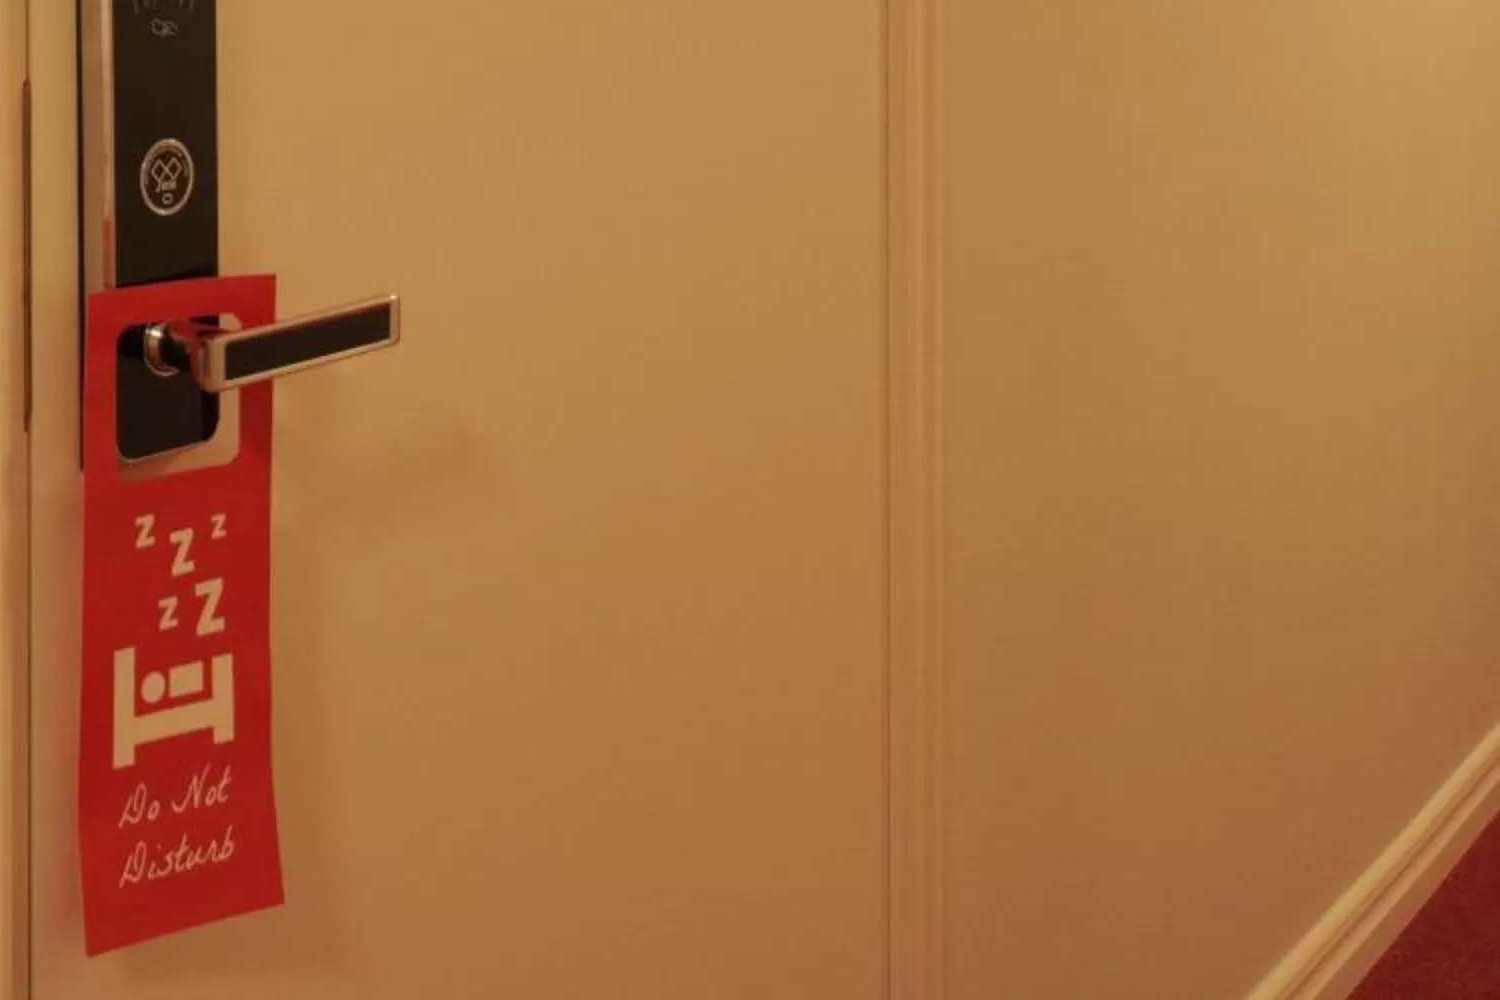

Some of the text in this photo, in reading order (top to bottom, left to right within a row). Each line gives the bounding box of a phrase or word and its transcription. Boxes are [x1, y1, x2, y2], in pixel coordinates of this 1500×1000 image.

[118, 762, 232, 828] Do Not
[119, 824, 234, 889] Disturb
